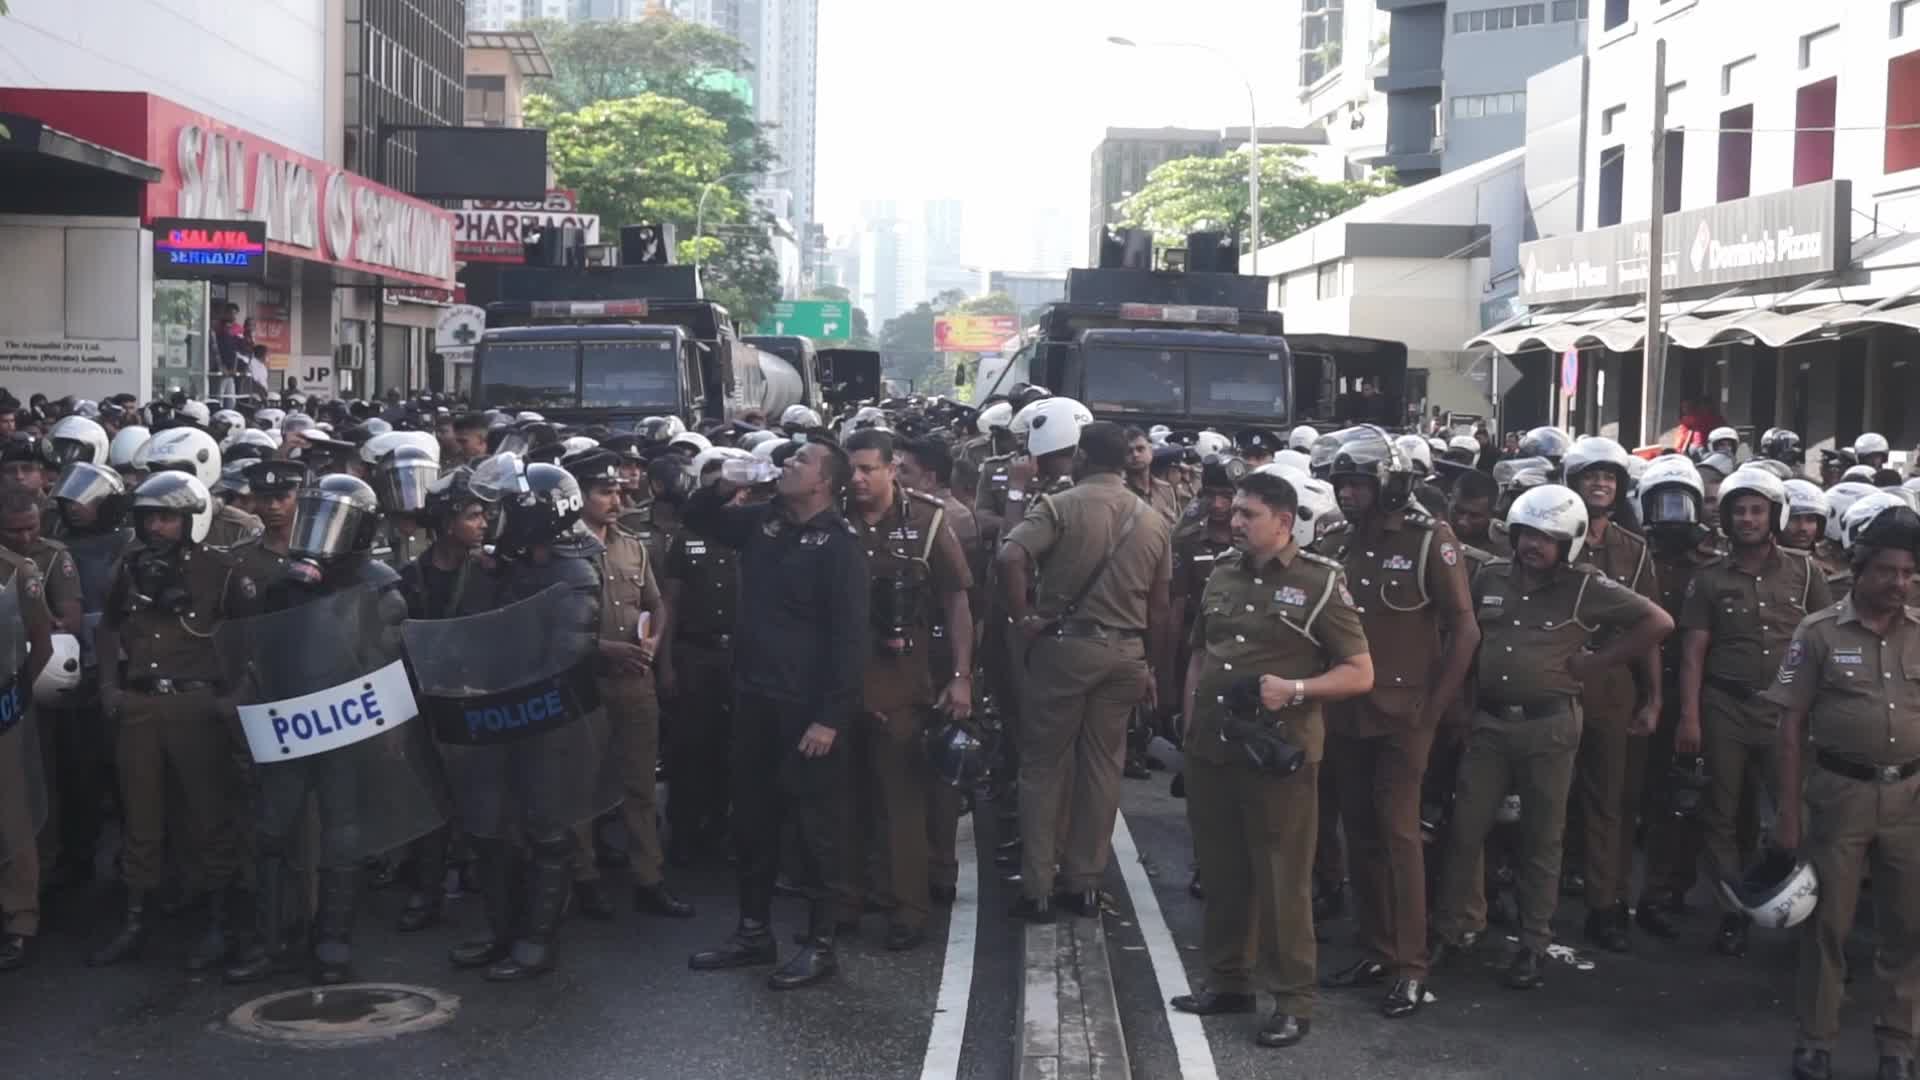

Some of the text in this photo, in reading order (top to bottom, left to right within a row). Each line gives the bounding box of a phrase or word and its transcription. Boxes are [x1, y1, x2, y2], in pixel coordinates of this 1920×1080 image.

[1709, 226, 1822, 269] Domino's Pizza
[304, 367, 331, 382] JP
[272, 690, 382, 744] POLICE
[464, 690, 562, 737] POLICE
